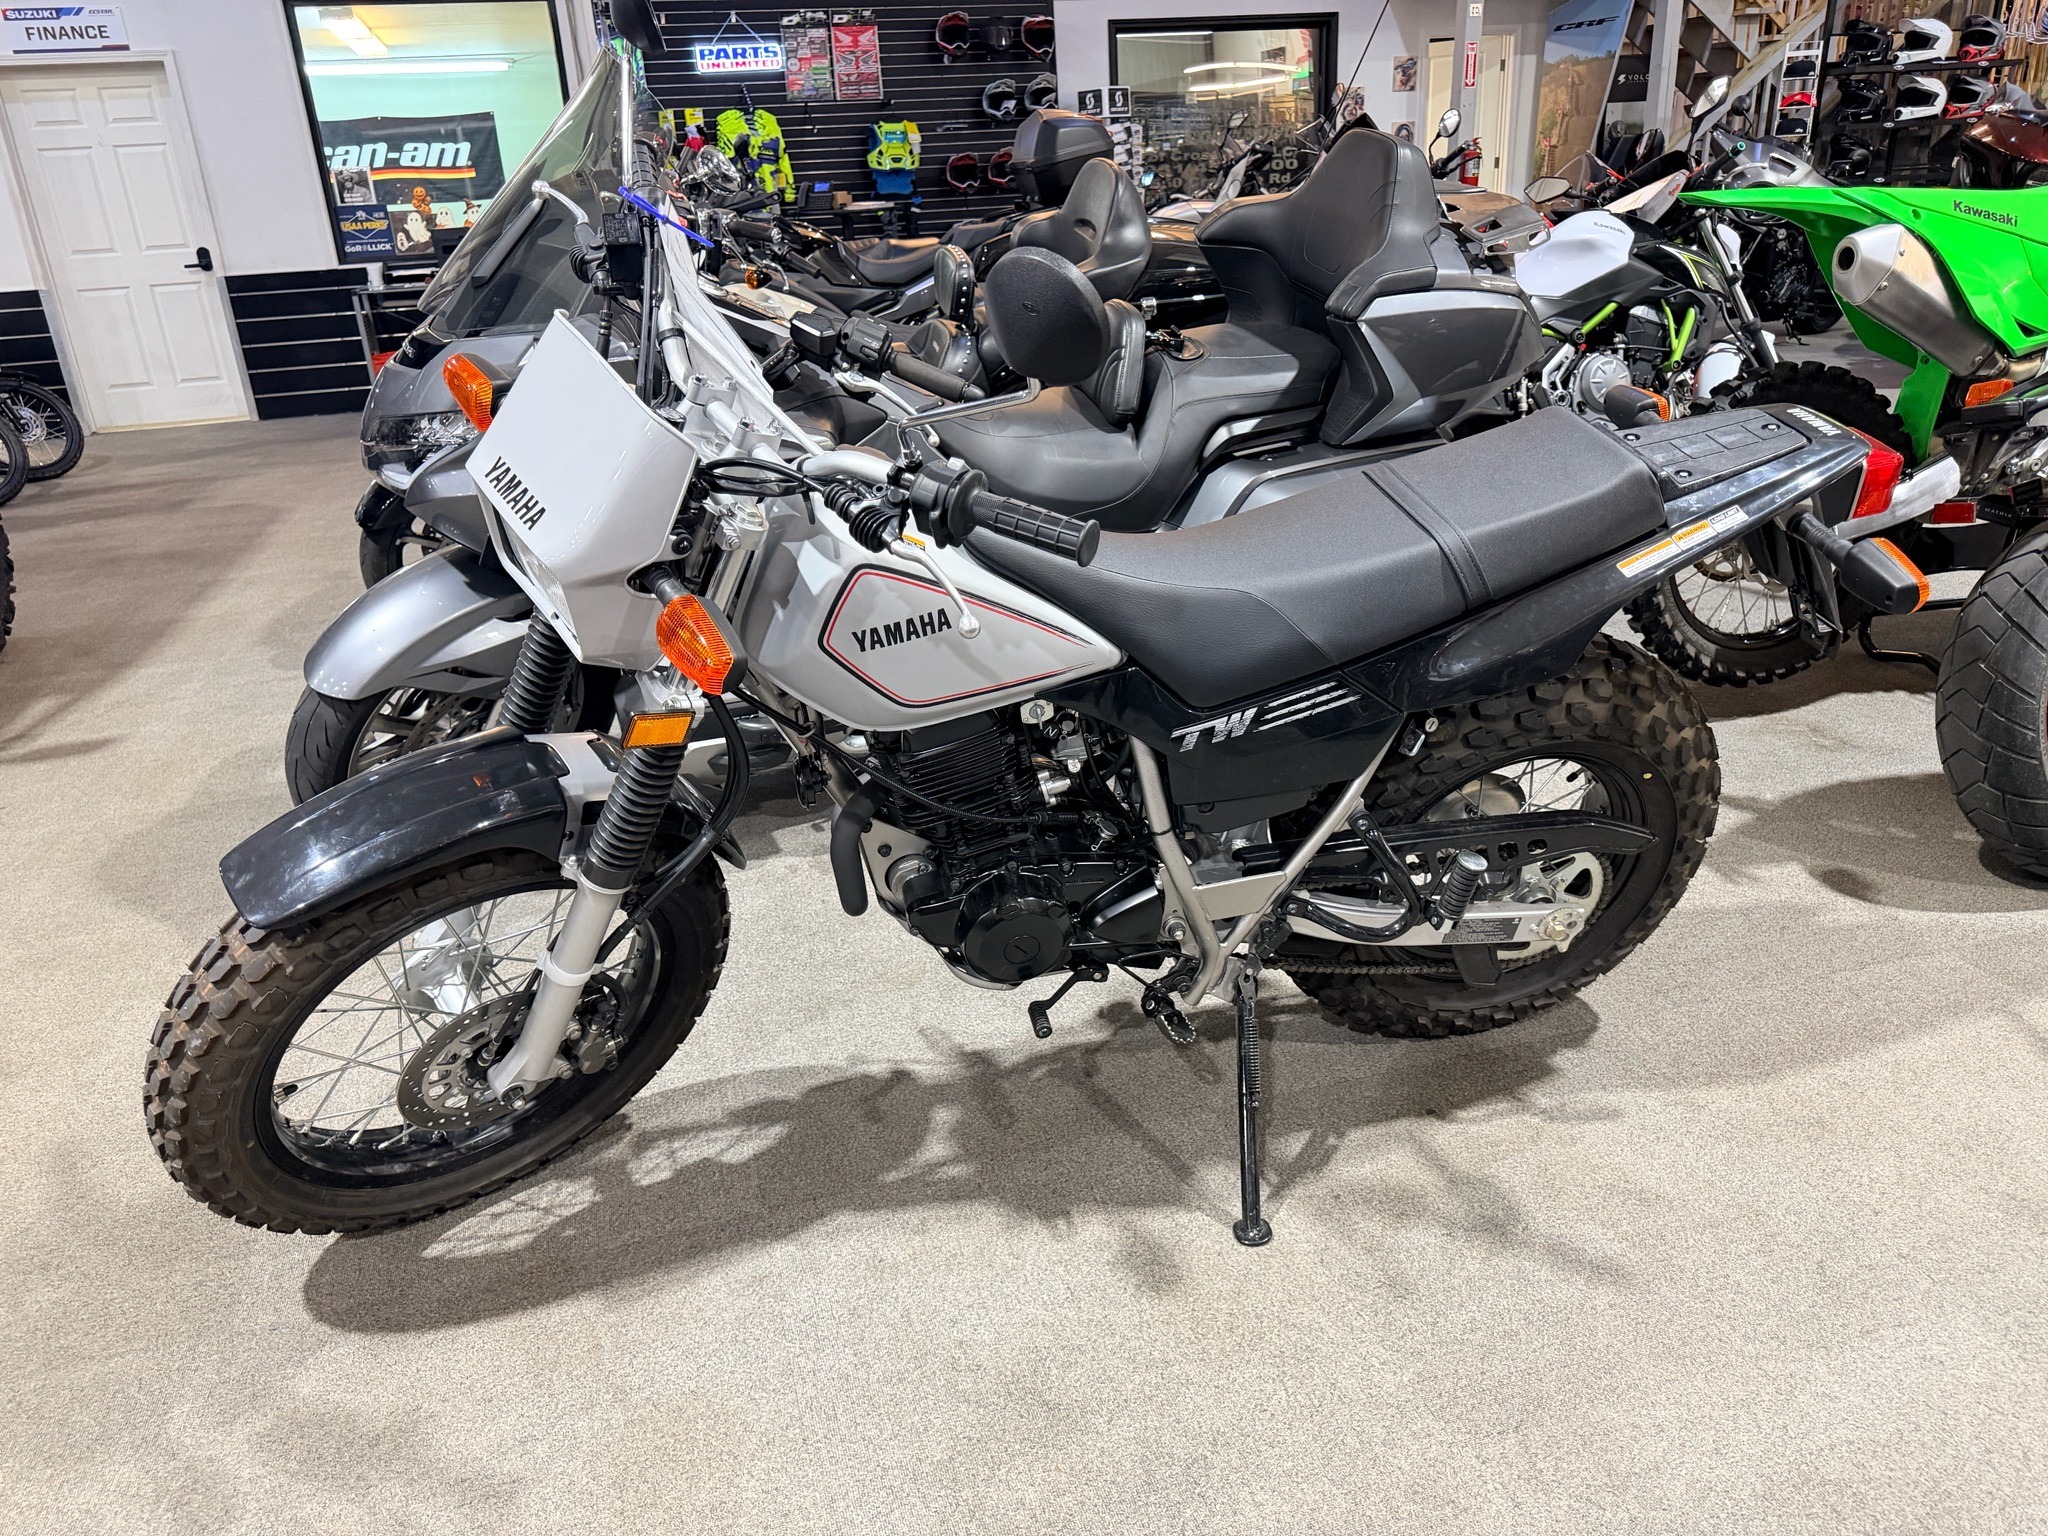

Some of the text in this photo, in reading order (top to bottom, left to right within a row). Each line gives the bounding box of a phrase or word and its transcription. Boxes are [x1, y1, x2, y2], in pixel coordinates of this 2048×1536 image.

[5, 10, 58, 19] SUZUKI
[1553, 16, 1619, 32] CRF
[25, 25, 110, 41] FINANCE
[699, 46, 779, 60] PARTS
[701, 60, 780, 70] UNLIMITED
[1953, 200, 2018, 227] Kawasaki
[1594, 221, 1626, 235] Kawasaki
[1786, 407, 1842, 436] YAMAHA
[484, 455, 546, 531] YAMAHA
[1710, 513, 1725, 524] LOAD
[1984, 507, 2012, 518] MATRIX
[1682, 524, 1706, 537] WARNING
[851, 608, 952, 652] YAMAHA
[1170, 706, 1258, 752] TW
